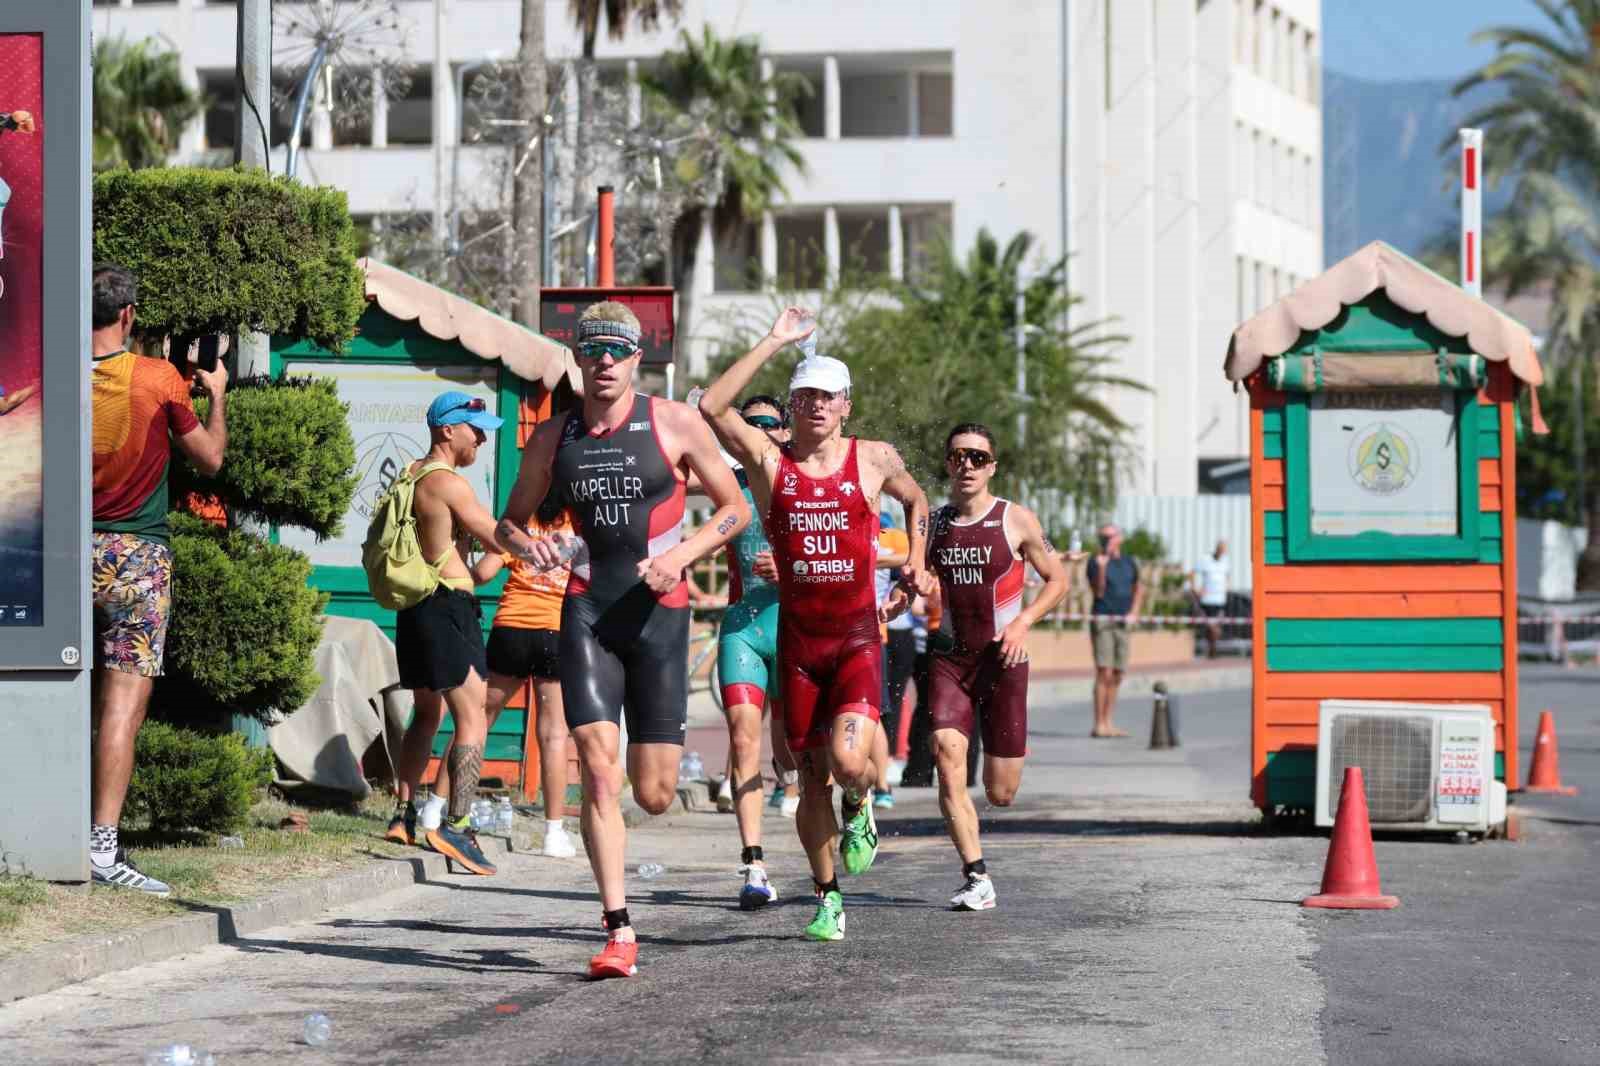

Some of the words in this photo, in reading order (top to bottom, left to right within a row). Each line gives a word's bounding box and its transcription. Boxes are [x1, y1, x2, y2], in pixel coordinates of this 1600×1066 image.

[570, 476, 645, 502] KAPELLER
[803, 500, 840, 509] DESCENTE
[594, 503, 631, 527] AUT
[789, 511, 850, 532] PENNONE
[803, 535, 838, 555] SUI
[940, 543, 993, 566] SZÉKELY
[793, 574, 856, 584] PERFORMANCE
[952, 567, 984, 585] HUN
